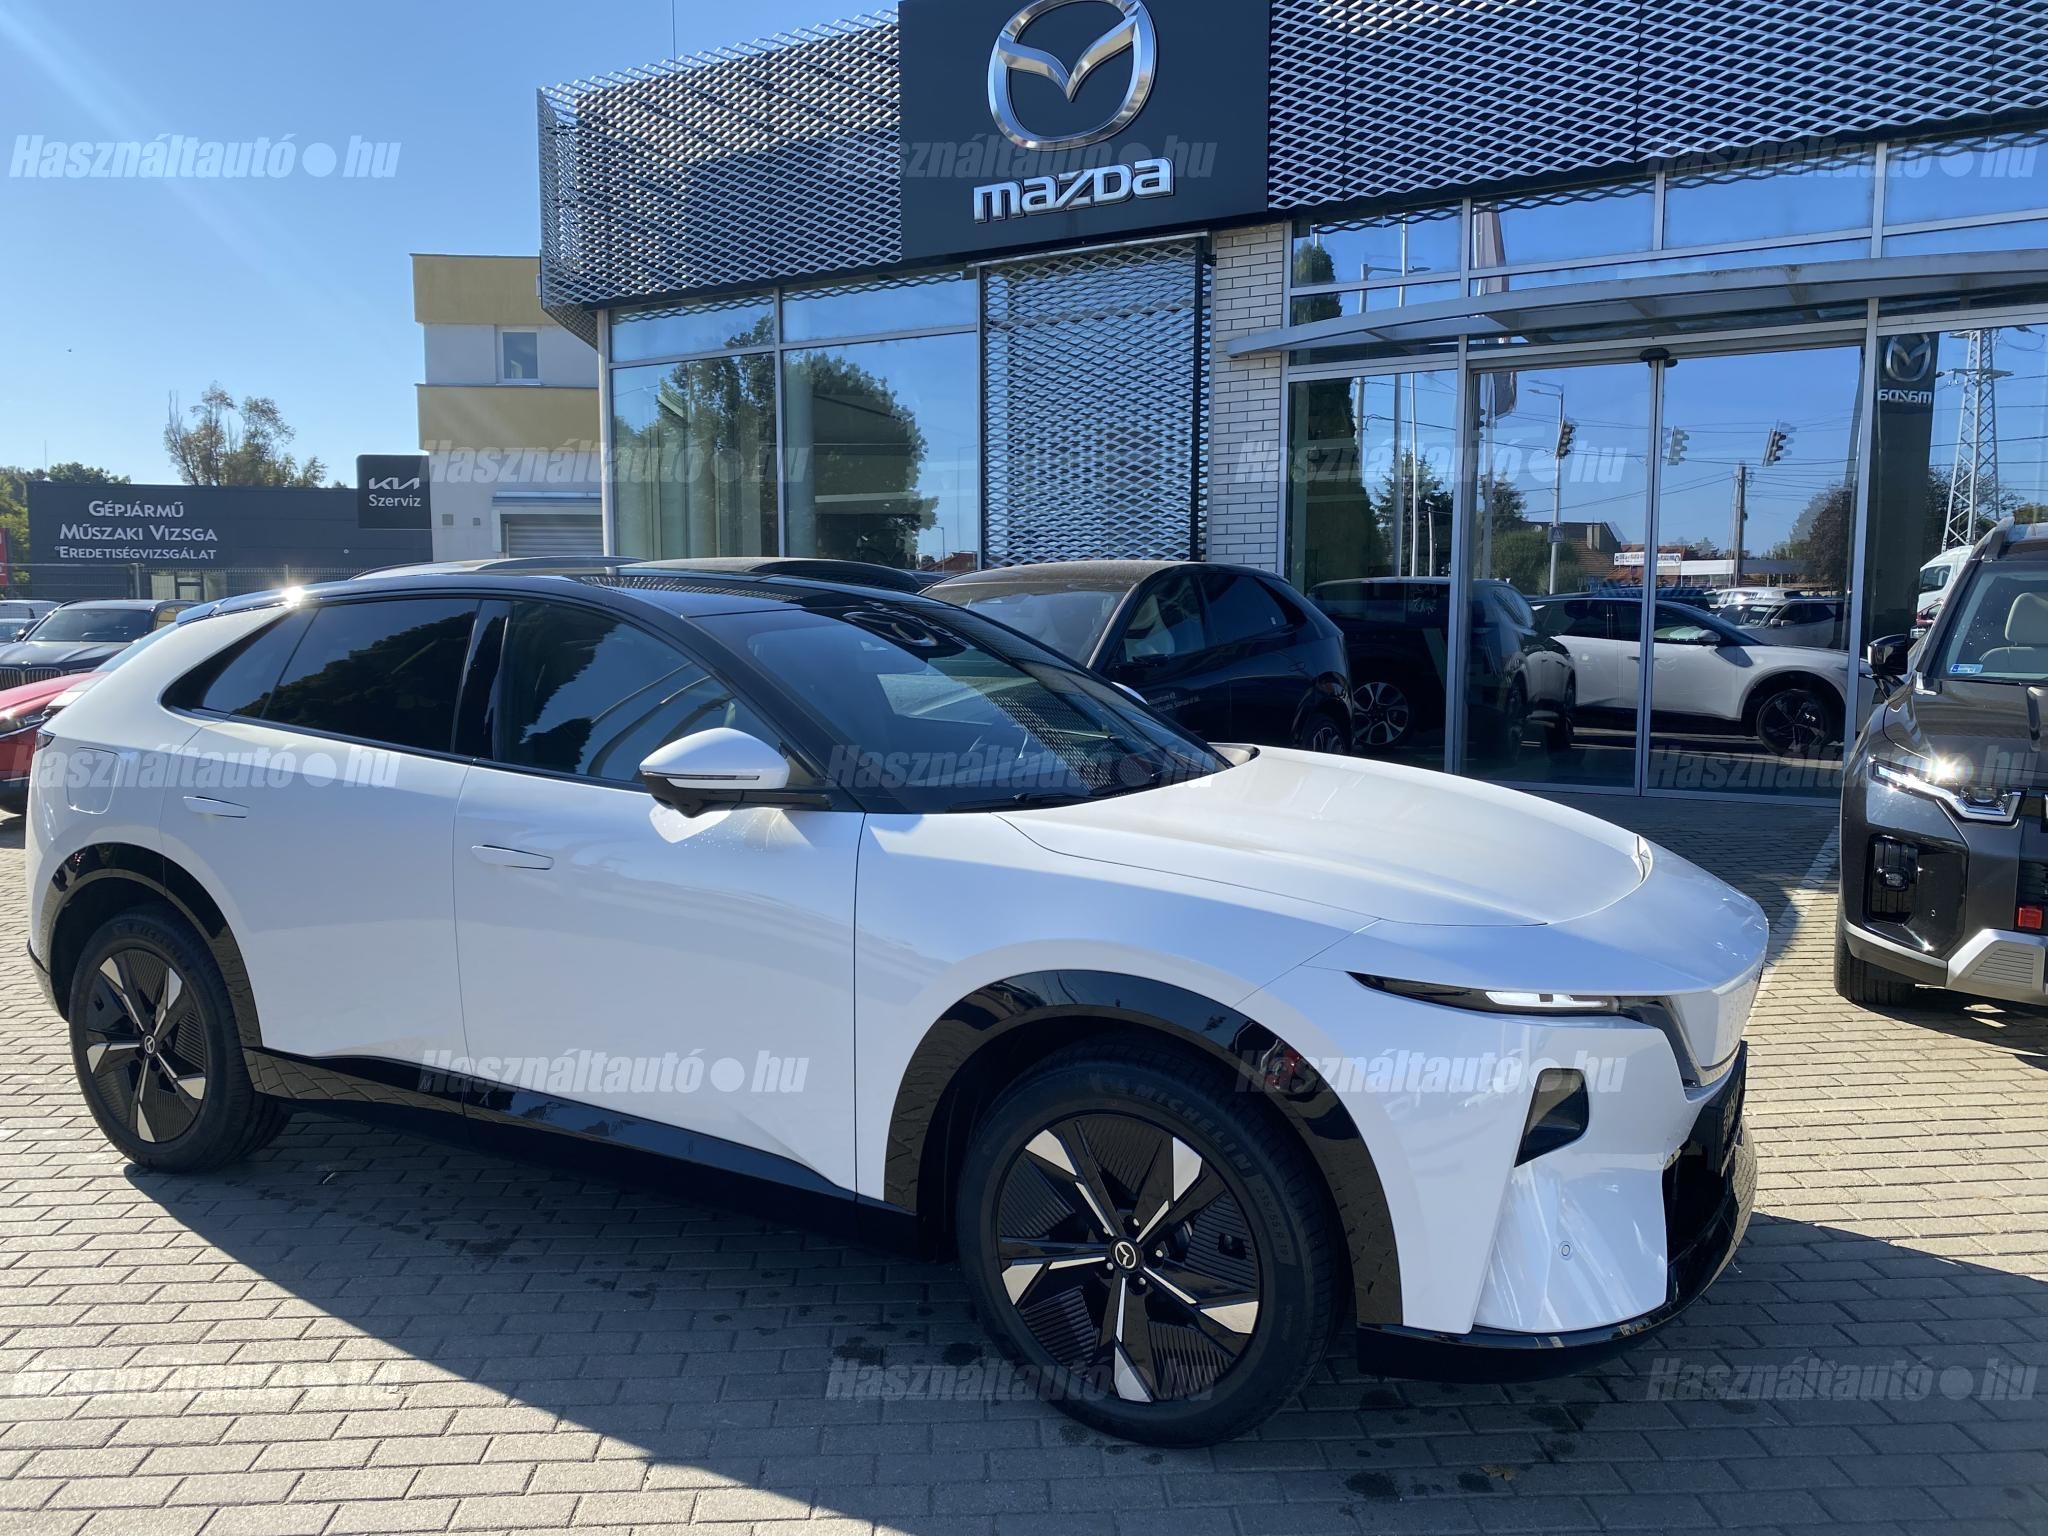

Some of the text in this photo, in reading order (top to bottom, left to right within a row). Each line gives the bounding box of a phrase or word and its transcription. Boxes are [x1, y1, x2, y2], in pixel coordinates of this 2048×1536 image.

[368, 477, 420, 490] KIA
[368, 494, 422, 507] Szerviz
[88, 500, 184, 518] GÉPJÁRMŰ
[59, 523, 218, 542] MŰSZAKI VIZSGA
[60, 545, 217, 560] EREDETISÉGVIZSGÁLAT
[1136, 1084, 1251, 1170] MICHELIN
